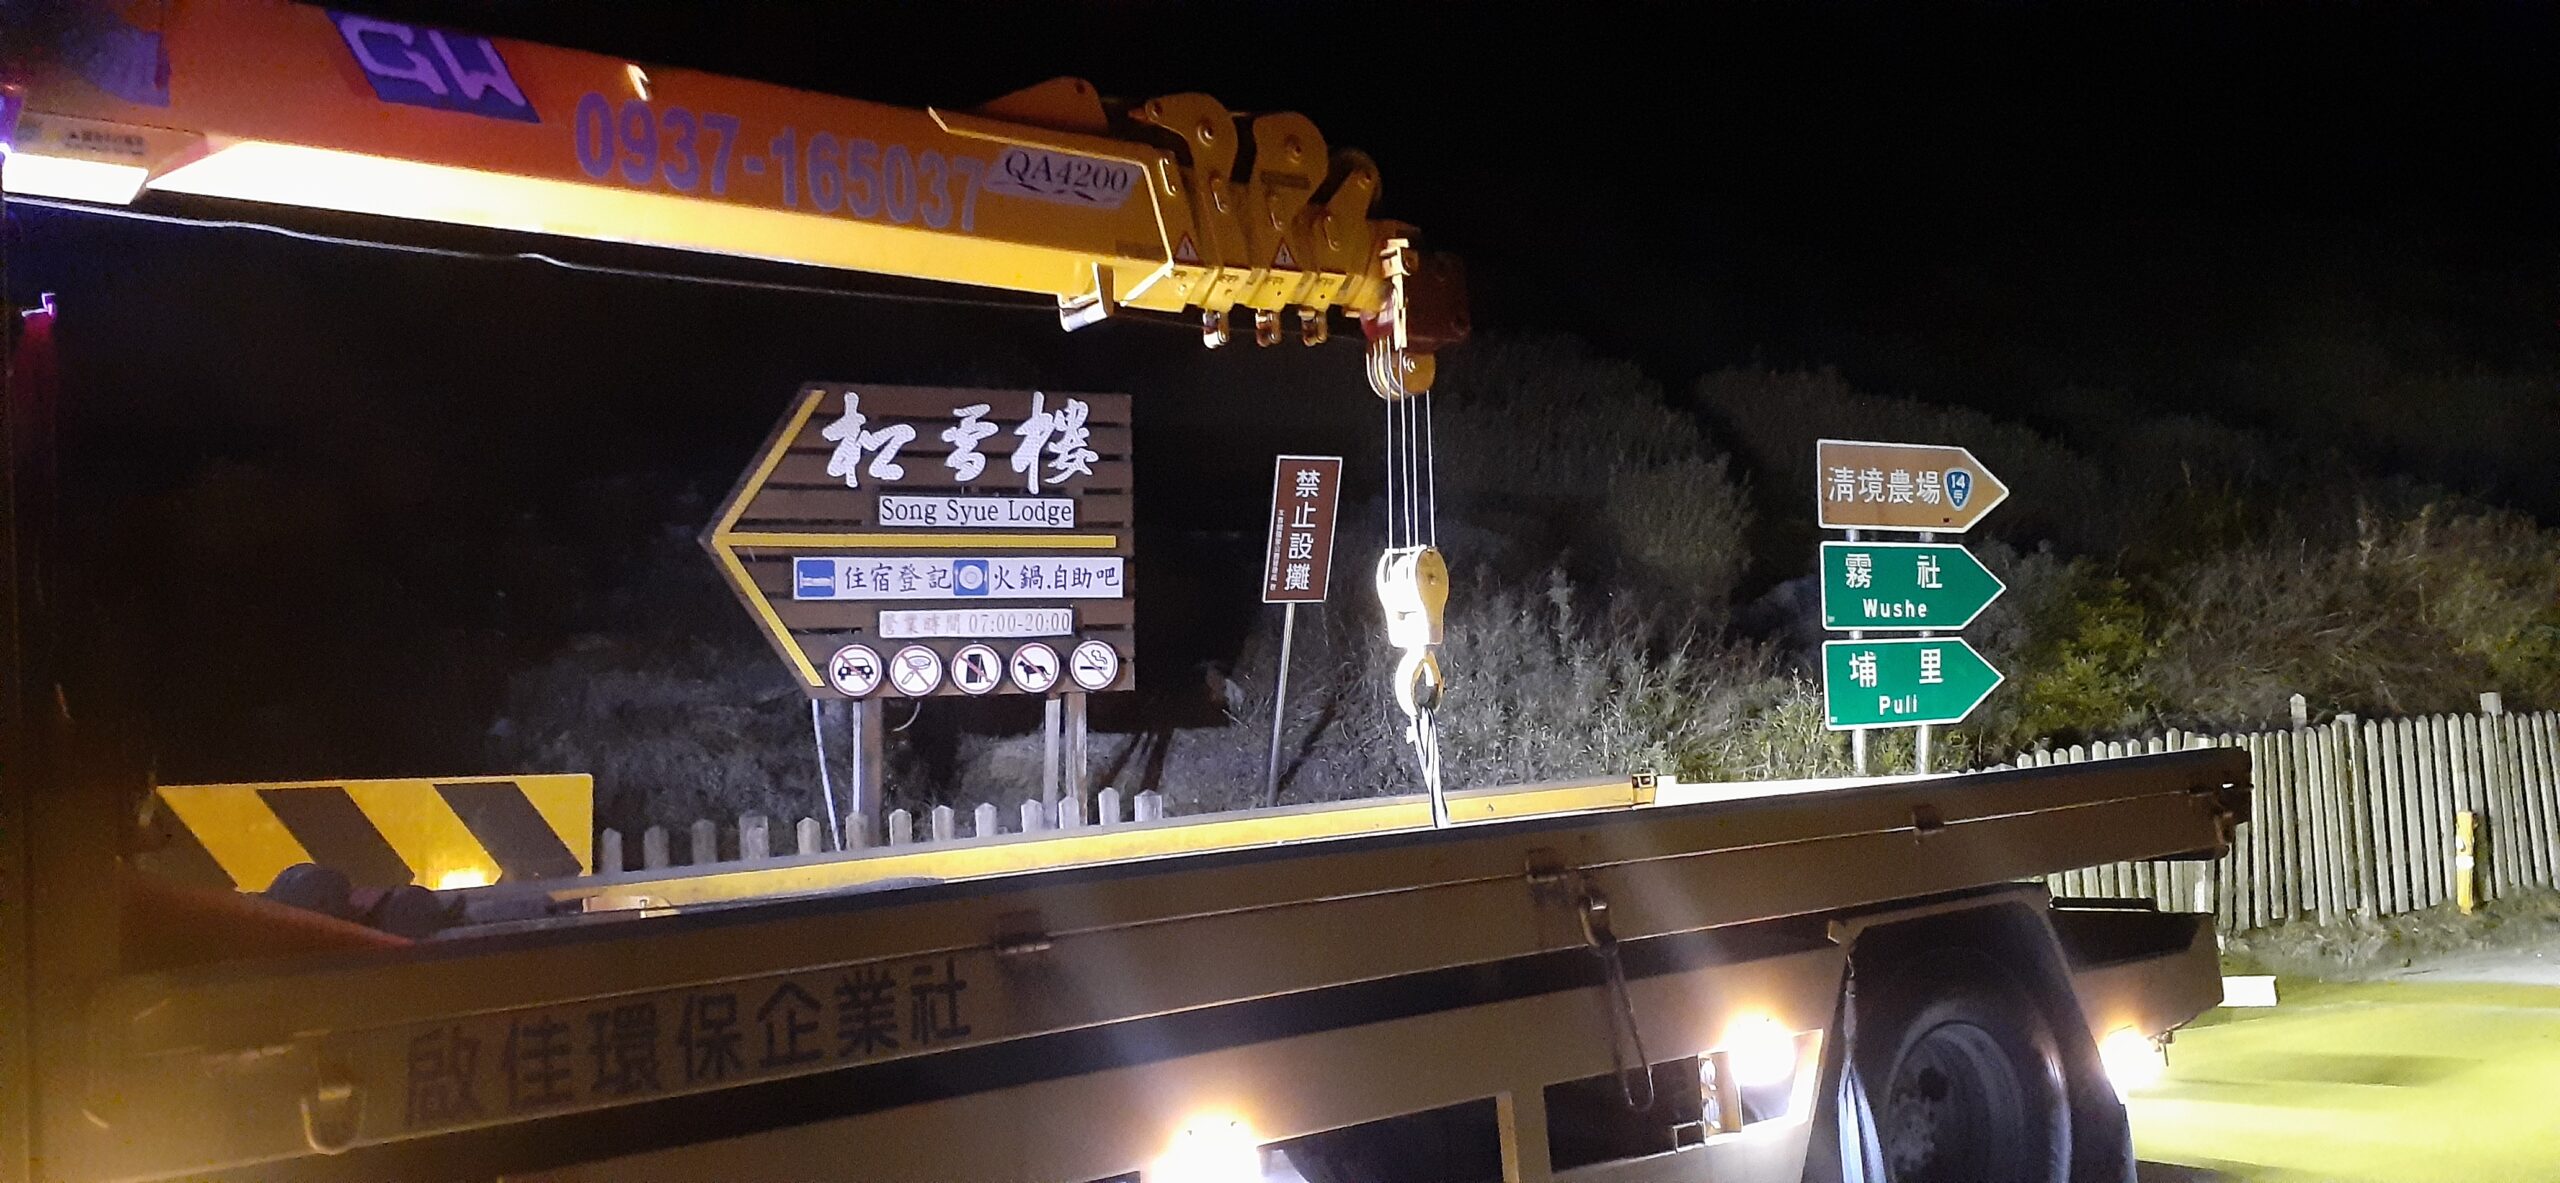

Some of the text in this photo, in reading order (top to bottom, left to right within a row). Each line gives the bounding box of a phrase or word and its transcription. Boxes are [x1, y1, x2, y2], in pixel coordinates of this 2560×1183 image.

[575, 91, 988, 233] 0937-165037
[1004, 147, 1128, 194] QA4200
[822, 391, 1099, 494] 松雪樓
[1828, 466, 1942, 505] 清境農場
[1951, 474, 1966, 489] 14
[881, 498, 1072, 523] Song Syue Lodge
[1284, 469, 1321, 591] 禁止設攤
[845, 563, 952, 592] 住宿登記
[1845, 553, 1943, 589] 霧社
[969, 611, 1070, 634] 07:00-20:00
[1862, 599, 1928, 618] Wushe
[1849, 648, 1944, 688] 埔里
[1879, 694, 1918, 715] Puli
